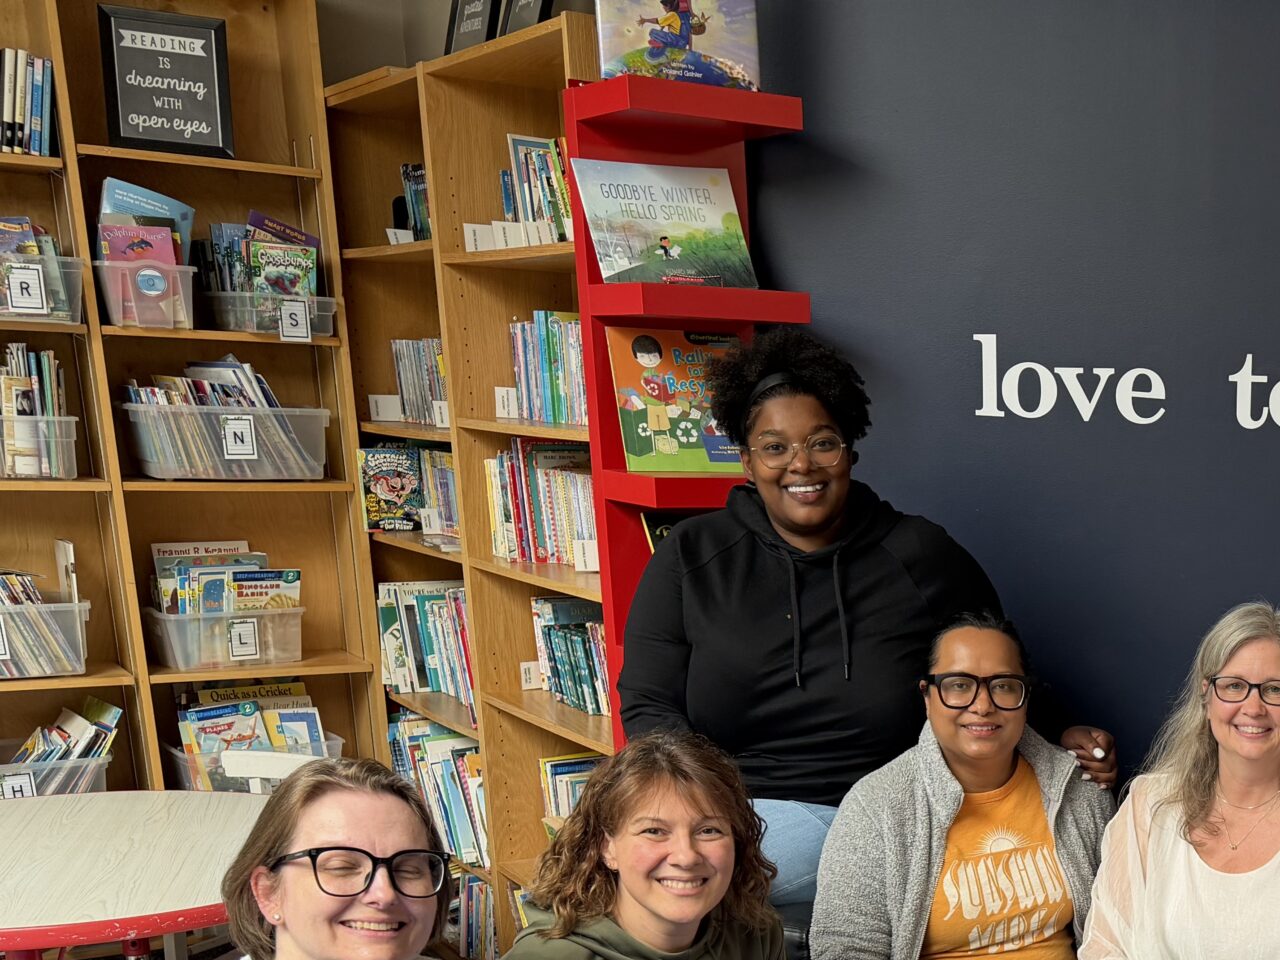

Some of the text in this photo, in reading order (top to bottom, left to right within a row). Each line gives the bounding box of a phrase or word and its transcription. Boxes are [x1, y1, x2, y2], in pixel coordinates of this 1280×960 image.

[130, 33, 196, 53] READING
[157, 56, 171, 69] IS
[125, 69, 207, 101] dreaming
[152, 95, 183, 110] WITH
[127, 112, 212, 139] open eyes
[600, 182, 657, 202] GOODBYE
[619, 202, 707, 223] HELLO SPRING
[103, 228, 167, 240] Dolphin Diaries
[264, 219, 306, 241] SMART WORDS
[258, 248, 314, 276] Goosebumps
[19, 281, 32, 297] R
[288, 312, 299, 327] S
[687, 366, 705, 377] for
[972, 332, 1167, 425] love
[665, 374, 706, 397] Recy
[232, 430, 244, 445] N
[287, 572, 295, 580] 2
[238, 632, 248, 645] L
[210, 689, 240, 702] Quick
[241, 691, 251, 699] as
[258, 685, 293, 698] Cricket
[244, 704, 251, 713] 2
[11, 784, 24, 798] H
[943, 845, 1065, 921] SUNSHIN
